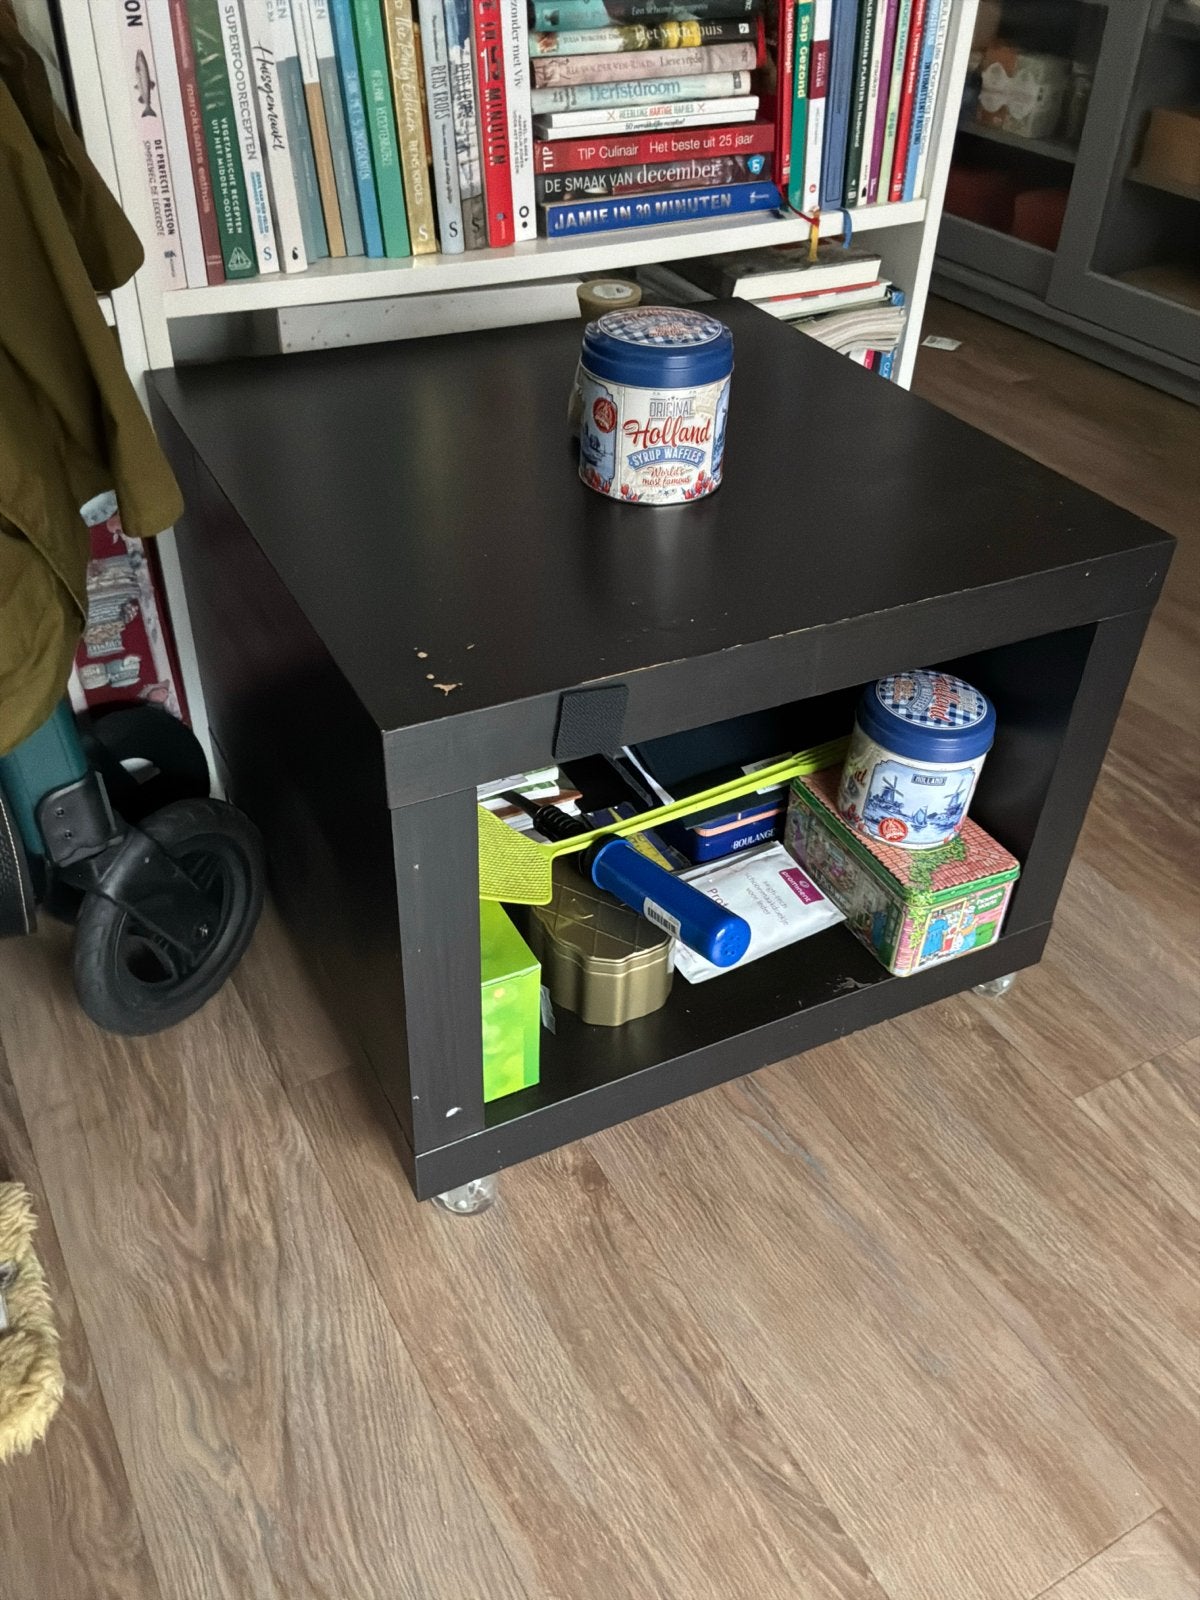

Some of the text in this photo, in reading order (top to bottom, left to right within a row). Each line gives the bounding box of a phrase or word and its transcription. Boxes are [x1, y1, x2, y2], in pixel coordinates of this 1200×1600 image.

[863, 19, 872, 58] BLOEMEN
[512, 44, 521, 68] met
[797, 15, 810, 99] Sap Gezond
[225, 5, 258, 161] SUPERFOODRECEPTEN
[430, 64, 447, 90] RENS
[514, 69, 524, 87] Viv
[589, 81, 681, 101] Herfstdroom
[859, 66, 868, 102] PLANTEN
[252, 41, 287, 151] Huisgemaakt
[432, 91, 451, 121] KROES
[542, 146, 554, 171] TIP
[577, 133, 754, 161] TIP Culinair Het beste uit 25 jaar
[154, 139, 176, 236] DE PERFECTE PRESTON
[211, 119, 235, 235] UIT HET MIDDEN-OOSTEN
[220, 117, 243, 235] VEGETARISCHE RECEPTEN
[544, 159, 719, 194] DE SMAAK VAN december
[554, 208, 609, 231] JAMIE
[613, 205, 631, 220] IN
[636, 202, 651, 218] 30
[655, 193, 732, 216] MINUTEN
[649, 400, 695, 418] ORIGINAL
[623, 416, 711, 449] Holland
[632, 447, 702, 466] SYRUP WAFFLES
[781, 871, 811, 903] prominent
